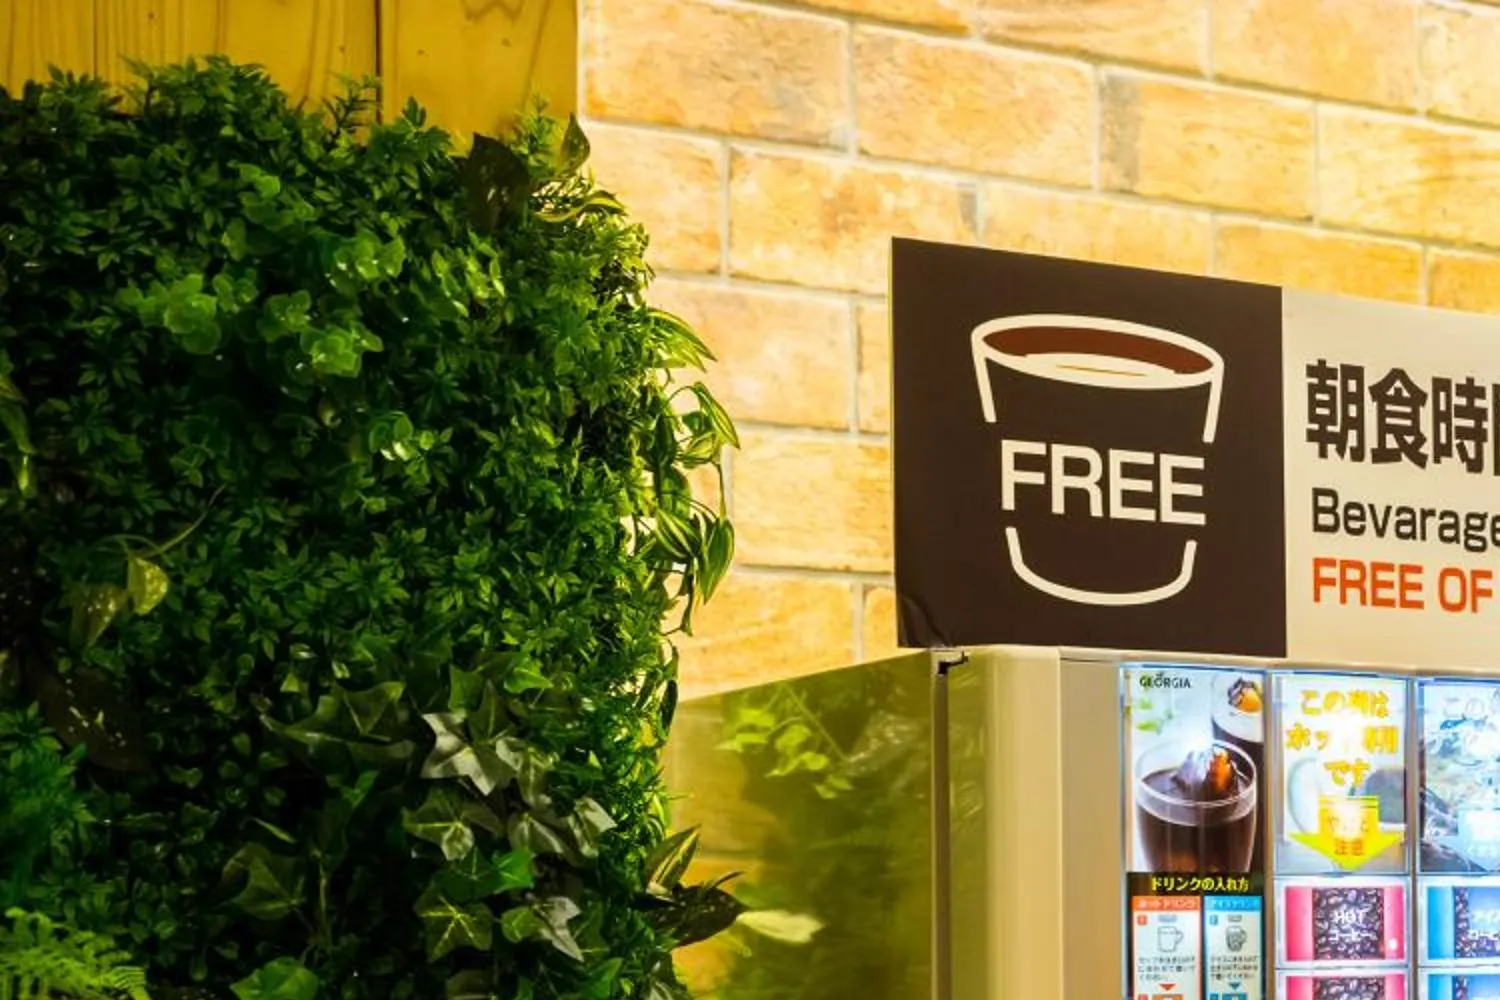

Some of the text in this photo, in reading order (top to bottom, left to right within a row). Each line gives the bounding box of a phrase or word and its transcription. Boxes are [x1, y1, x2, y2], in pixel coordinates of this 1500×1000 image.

[1001, 438, 1206, 526] FREE
[1311, 556, 1424, 610] FREE
[1437, 565, 1494, 614] OF
[1139, 675, 1192, 689] GEORGIA
[1152, 877, 1249, 891] ドリンクの入れ方
